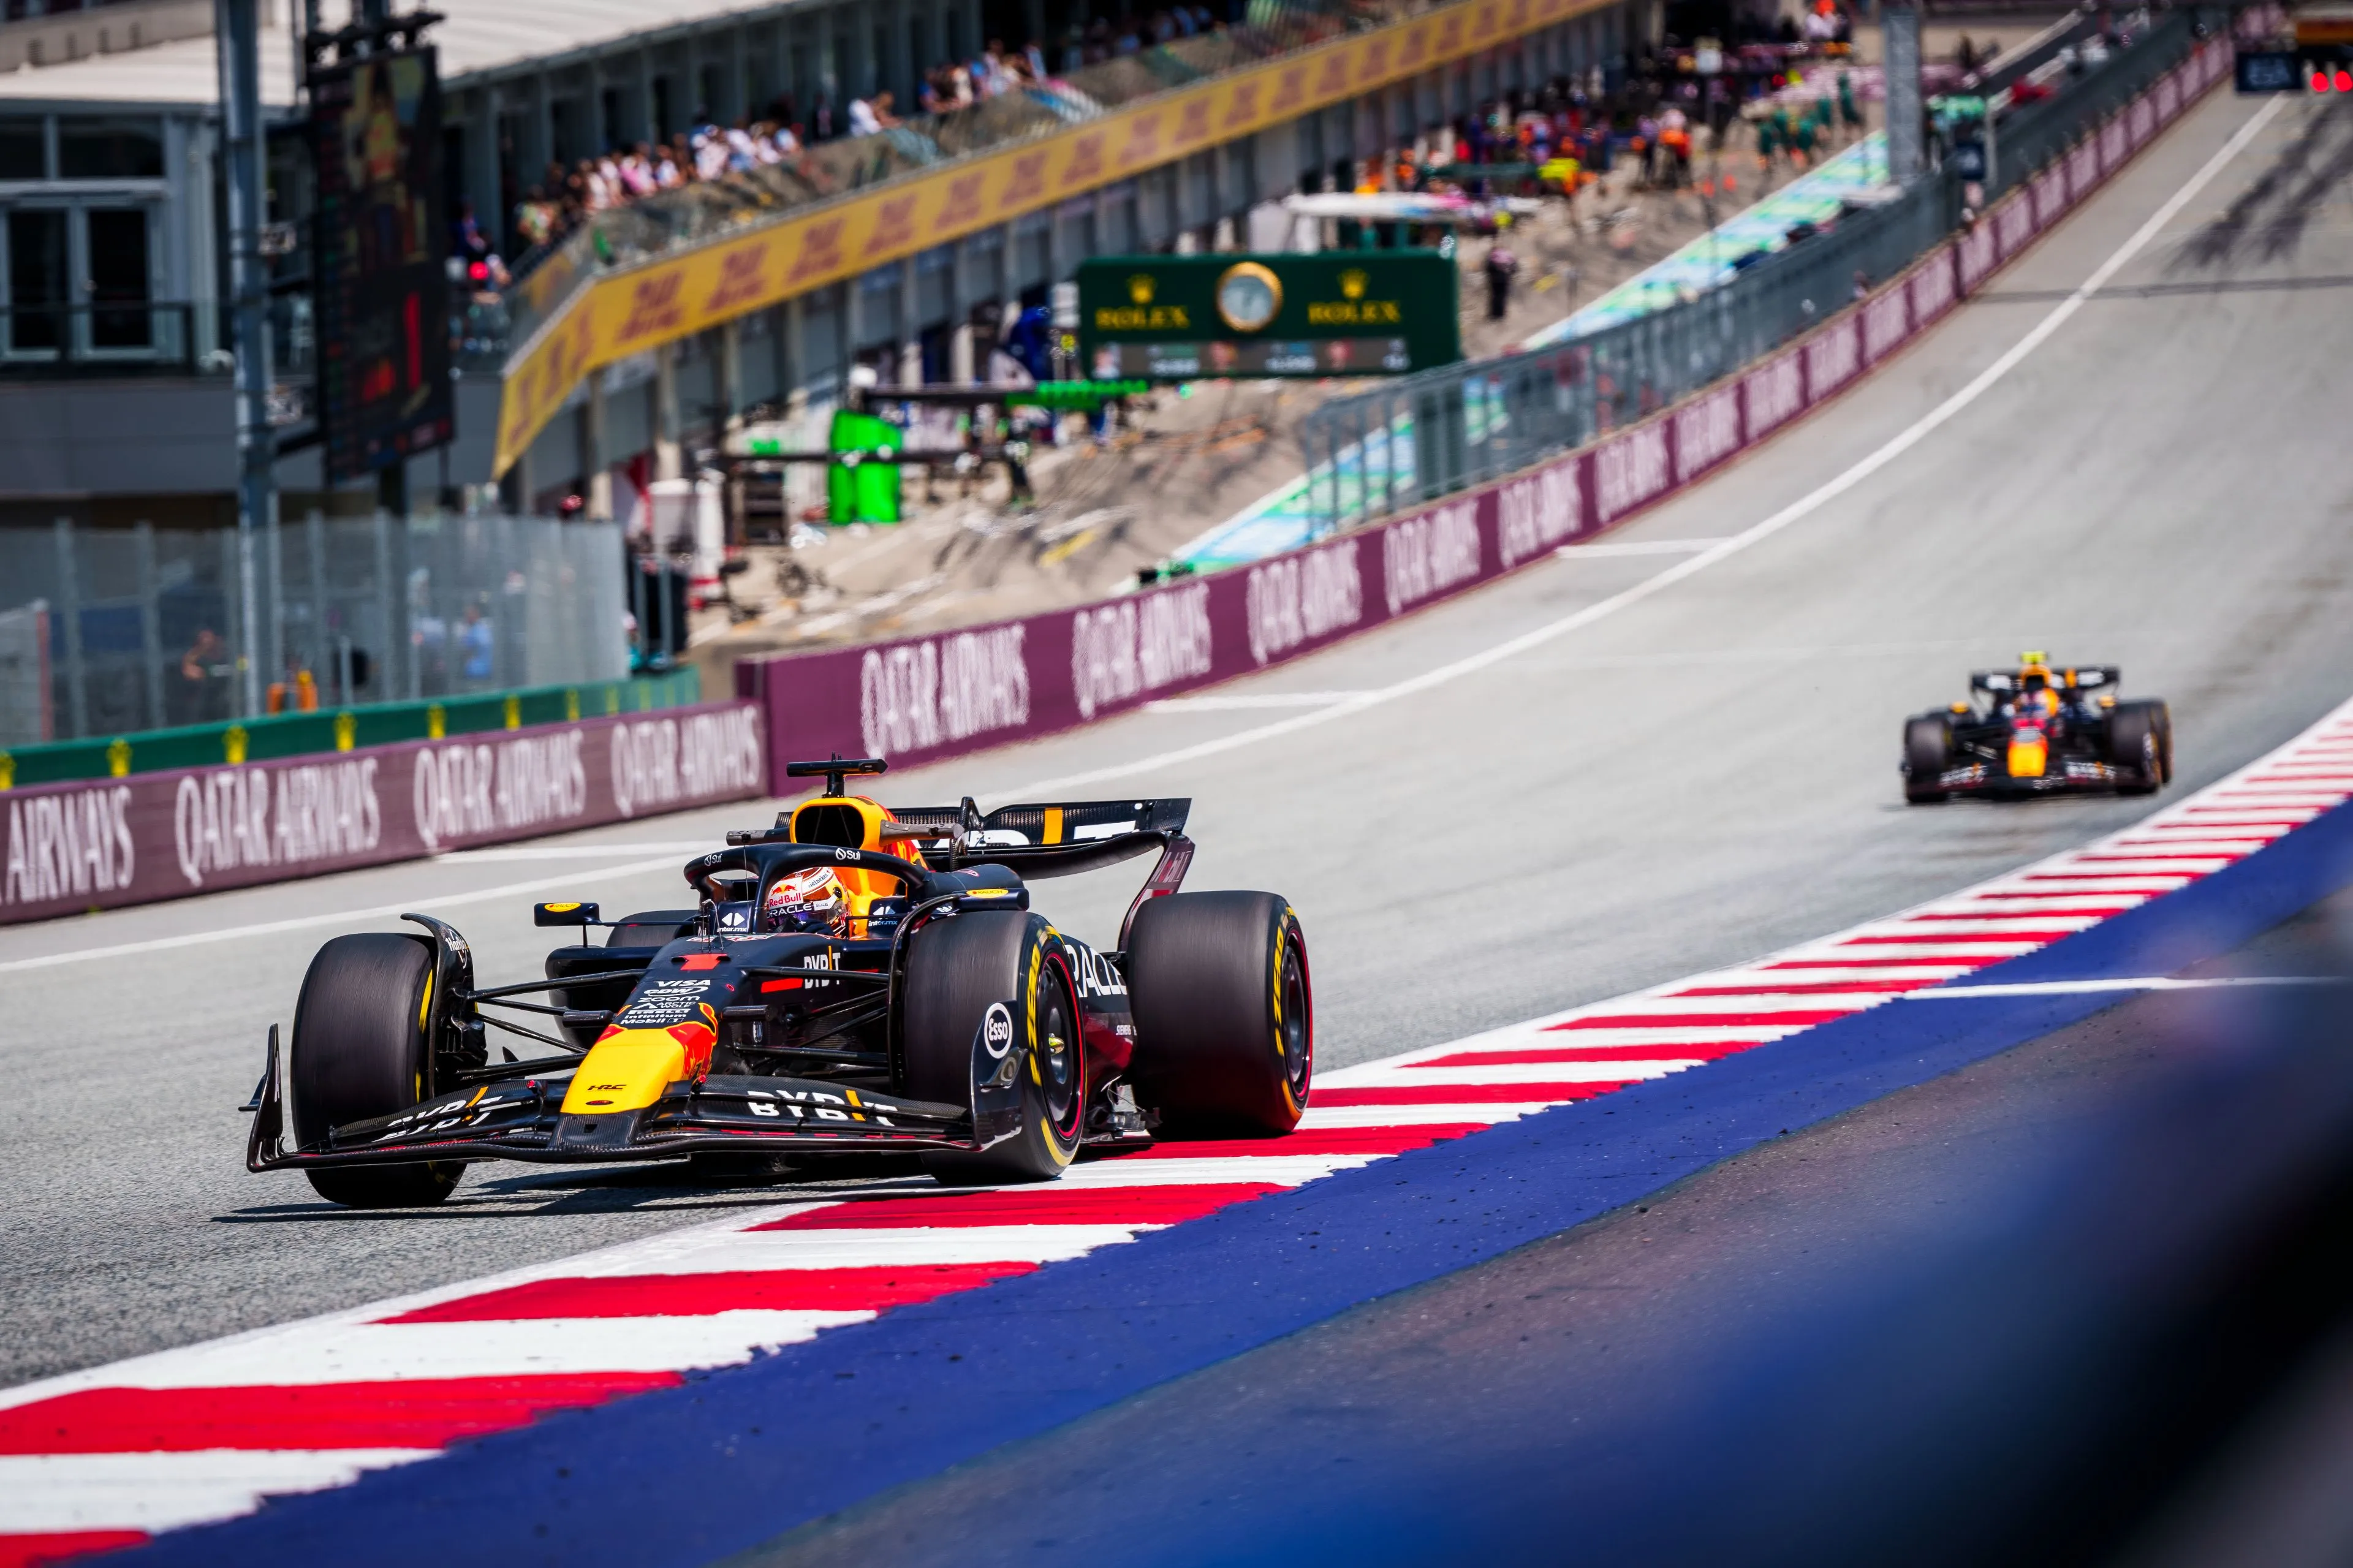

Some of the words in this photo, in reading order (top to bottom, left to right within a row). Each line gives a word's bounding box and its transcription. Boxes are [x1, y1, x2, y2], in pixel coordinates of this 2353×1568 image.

[1096, 308, 1189, 329] ROLEX
[1308, 301, 1401, 325] ROLEX
[610, 718, 681, 817] QATAR
[680, 704, 760, 795] AIRWAYS
[413, 743, 494, 850] QATAR
[494, 727, 586, 831] AIRWAYS
[175, 768, 270, 887] QATAR
[271, 757, 381, 864] AIRWAYS
[6, 785, 134, 904] AIRWAYS
[846, 850, 861, 860] Sui
[711, 854, 722, 864] Sui
[767, 902, 814, 918] ORACLE
[769, 896, 784, 907] Red
[784, 893, 801, 904] Bull
[1064, 944, 1127, 998] RACLE
[988, 1018, 1009, 1041] Esso
[747, 1089, 898, 1127] BYBIT
